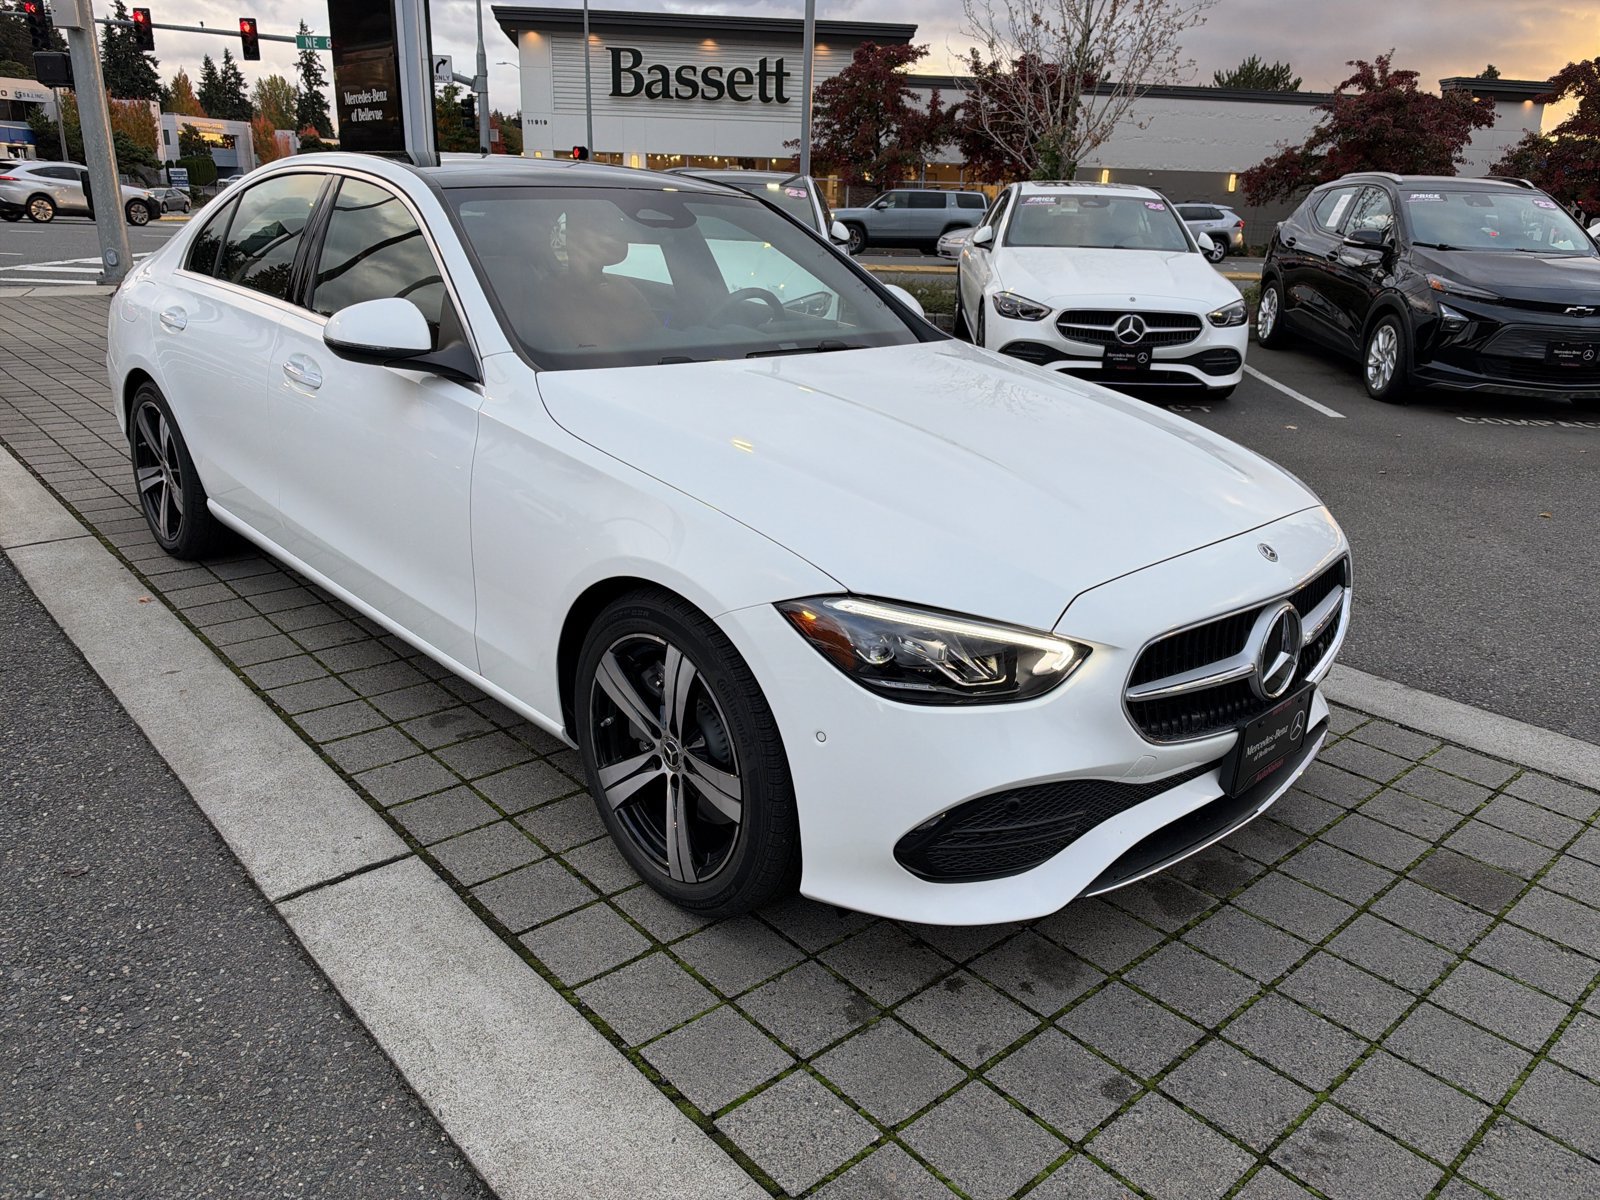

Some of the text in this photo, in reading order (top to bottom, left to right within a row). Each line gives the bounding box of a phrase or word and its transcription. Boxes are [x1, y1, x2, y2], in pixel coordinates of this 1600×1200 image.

[305, 38, 319, 48] NE
[606, 46, 791, 104] Bassett
[344, 89, 387, 105] Mercedes-Benz
[351, 107, 384, 122] of Bellevue
[1246, 725, 1288, 757] Mercedes-Benz
